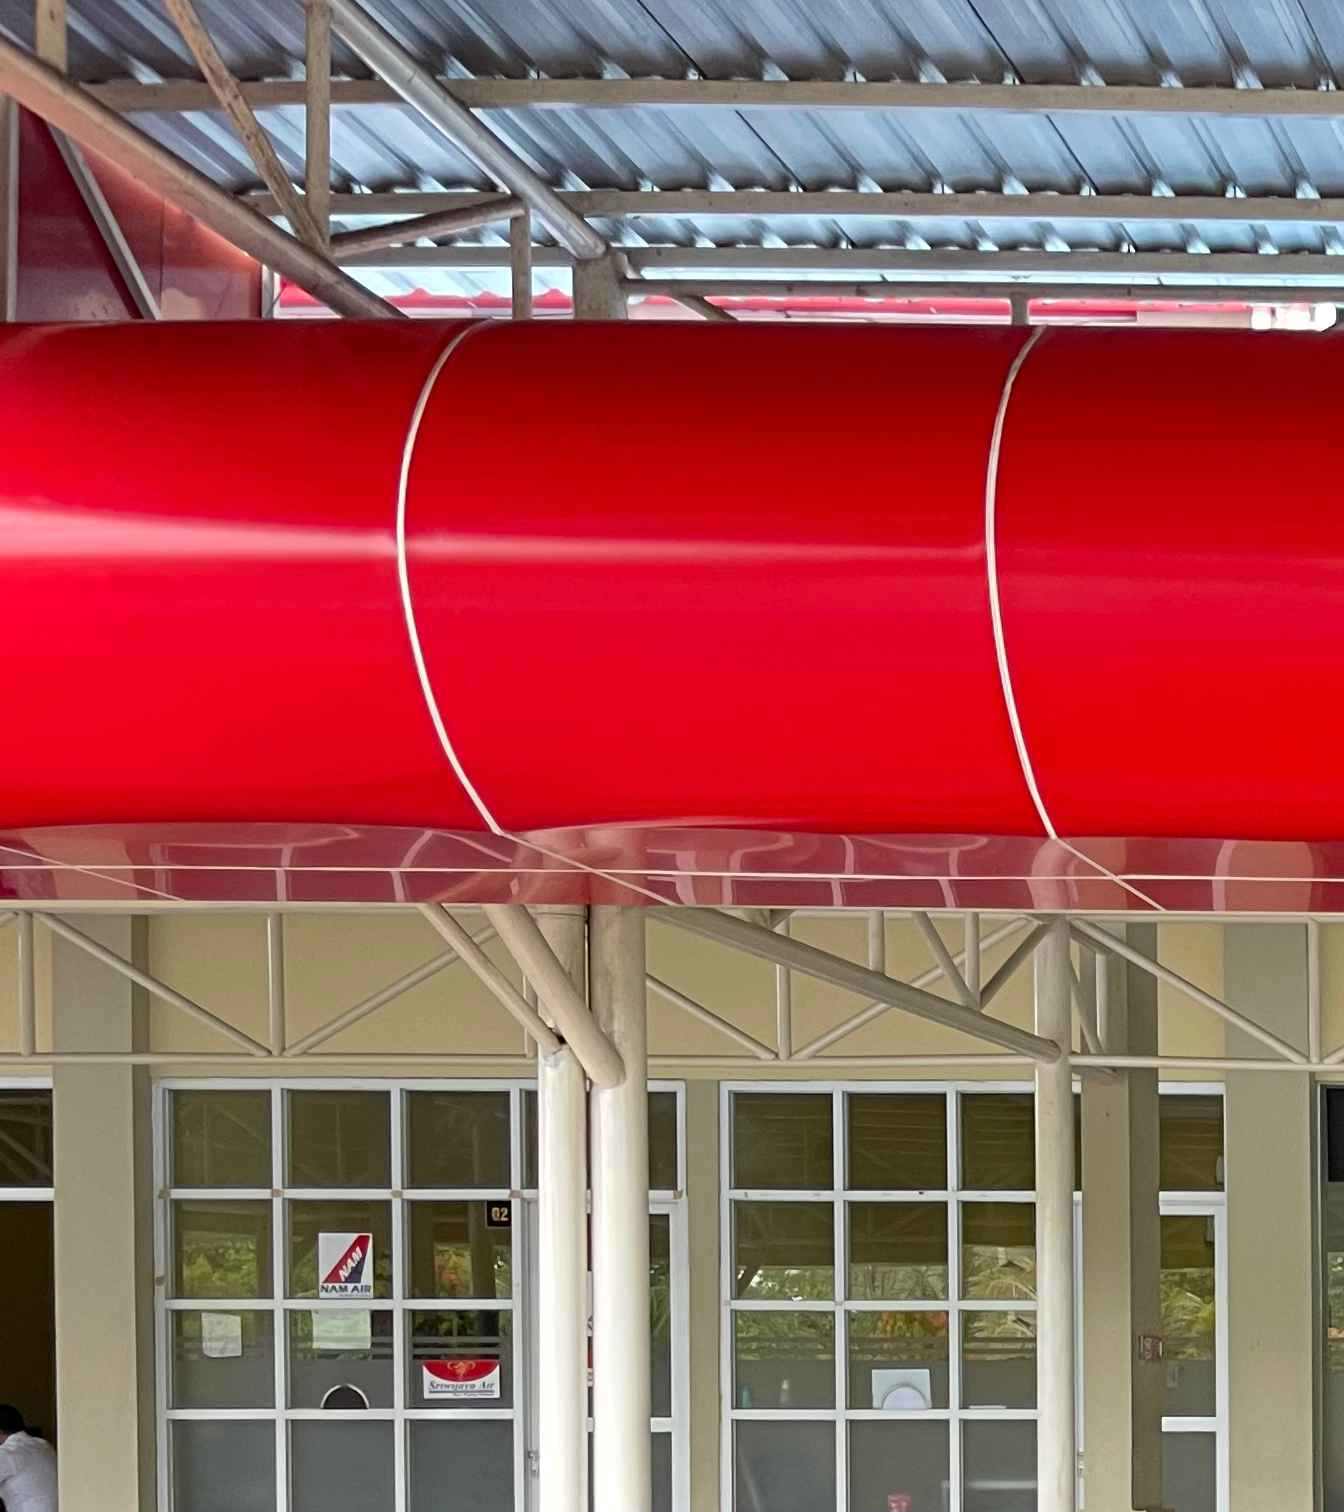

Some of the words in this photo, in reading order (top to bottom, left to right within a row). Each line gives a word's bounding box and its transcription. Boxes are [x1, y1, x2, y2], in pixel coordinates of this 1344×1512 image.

[338, 1245, 362, 1282] NAM
[320, 1284, 349, 1293] NAM
[351, 1284, 371, 1293] AIR
